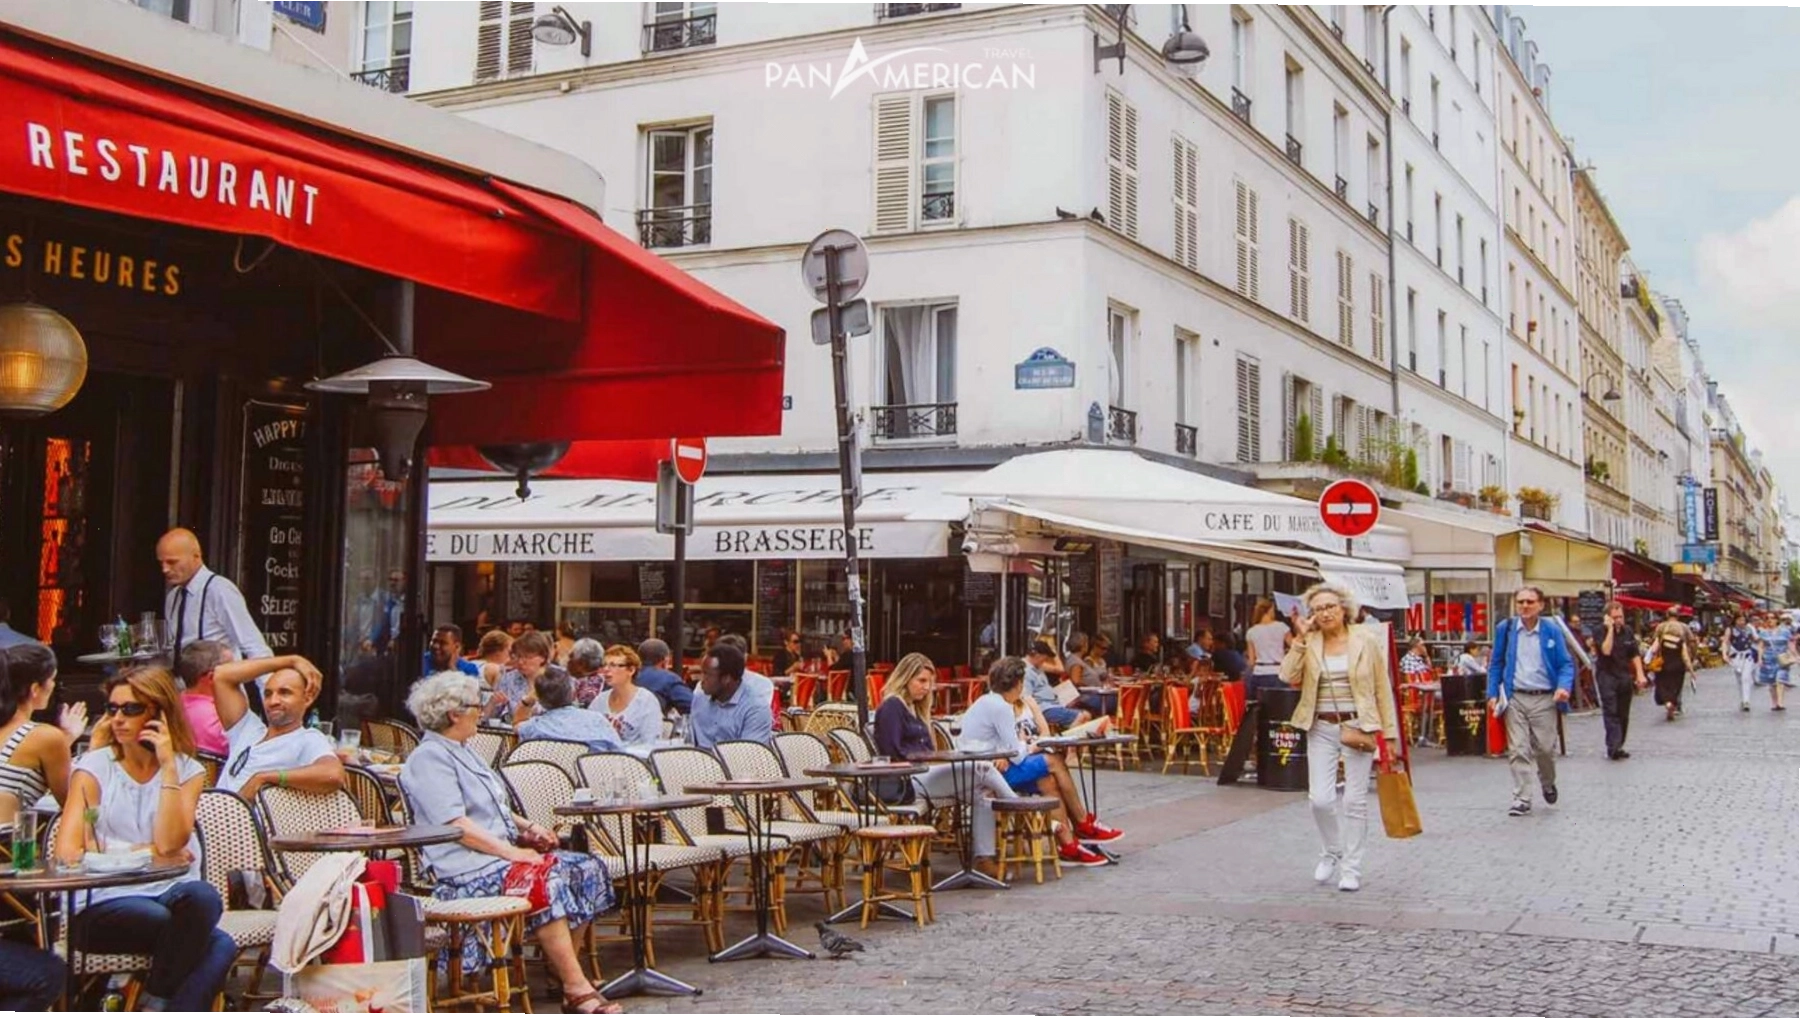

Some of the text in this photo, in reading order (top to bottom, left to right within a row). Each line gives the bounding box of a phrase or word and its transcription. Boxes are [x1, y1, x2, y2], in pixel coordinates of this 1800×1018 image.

[27, 122, 318, 225] RESTAURANT
[44, 241, 180, 296] HEURES
[253, 419, 298, 448] HAPPY
[1205, 511, 1254, 531] CAFE
[1263, 514, 1282, 532] DU
[1705, 490, 1716, 532] HOTEL
[450, 534, 480, 555] DU
[492, 532, 596, 556] MARCHE
[715, 528, 875, 553] BRASSERE
[1278, 748, 1291, 766] 7
